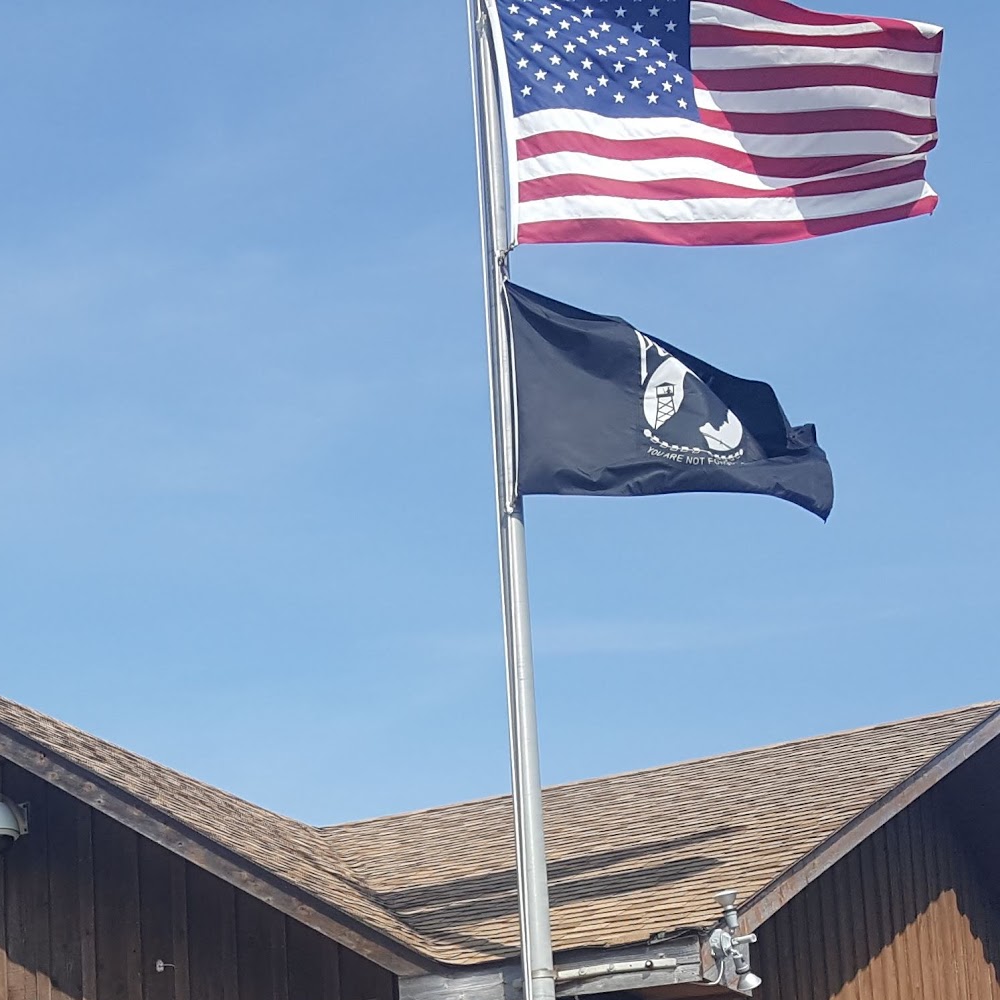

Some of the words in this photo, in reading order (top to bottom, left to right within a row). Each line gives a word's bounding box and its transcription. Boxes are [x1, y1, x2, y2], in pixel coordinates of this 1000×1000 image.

[647, 446, 664, 456] YOU
[663, 452, 684, 463] ARE
[685, 456, 705, 466] NOT
